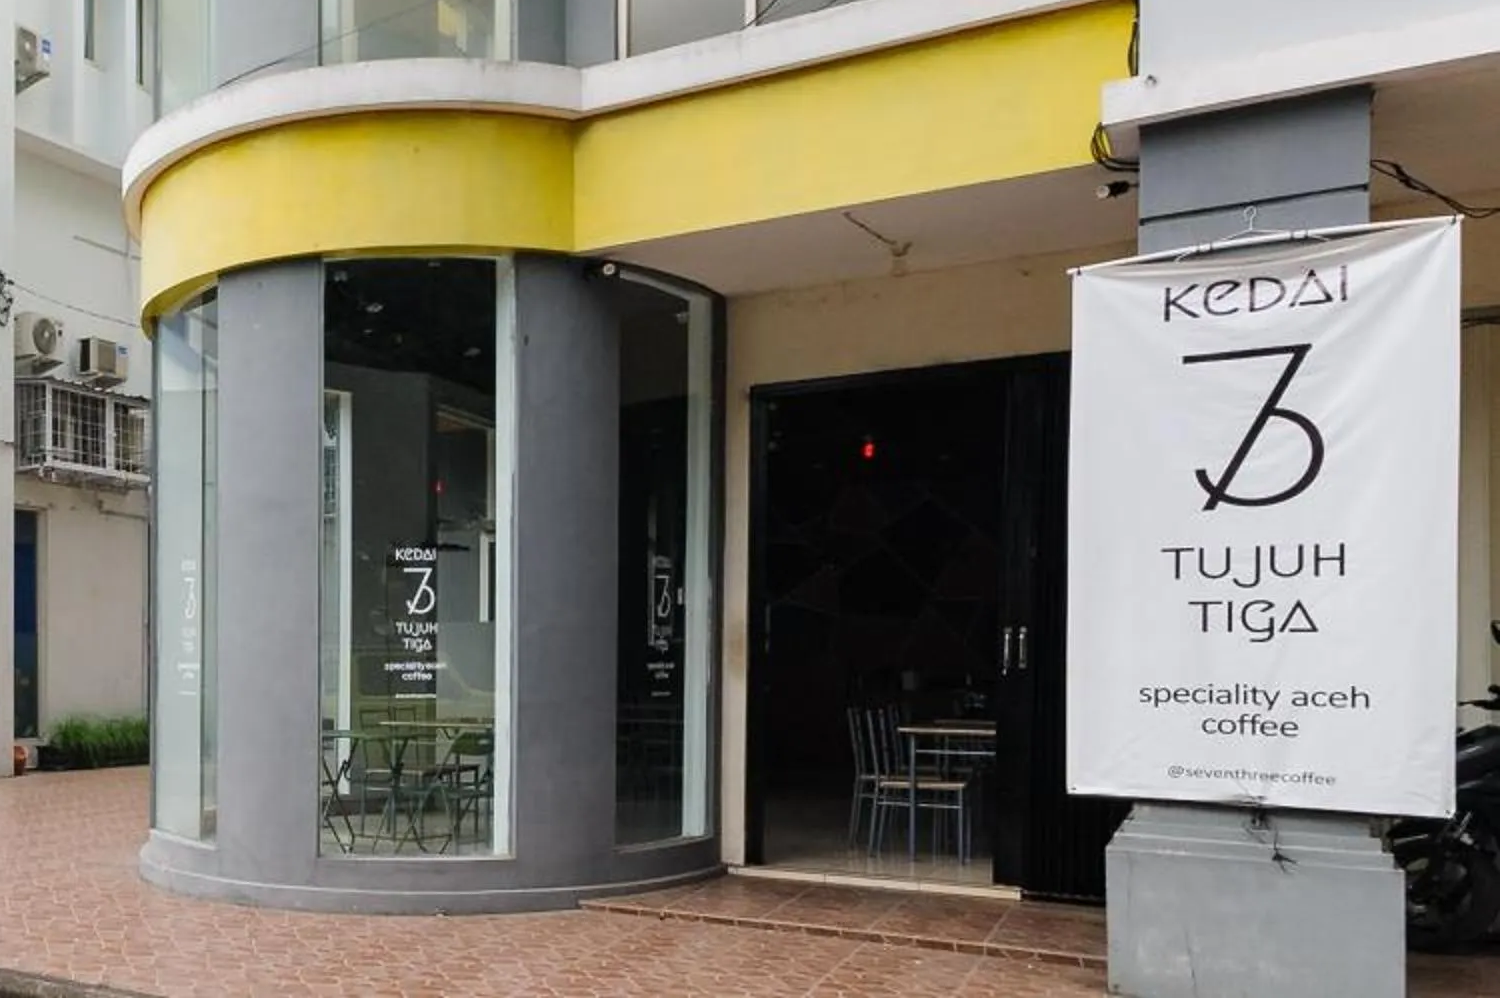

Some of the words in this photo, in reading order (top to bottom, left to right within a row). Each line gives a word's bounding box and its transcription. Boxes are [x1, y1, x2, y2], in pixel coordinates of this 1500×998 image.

[1160, 542, 1346, 589] TUJUH
[395, 621, 439, 637] TUJUH
[1187, 599, 1319, 643] TIGA
[403, 637, 433, 653] TIGA
[1139, 683, 1281, 711] speciality
[1290, 685, 1371, 709] aceh
[1201, 713, 1300, 738] coffee
[1167, 764, 1337, 787] @seventhreecoffee
